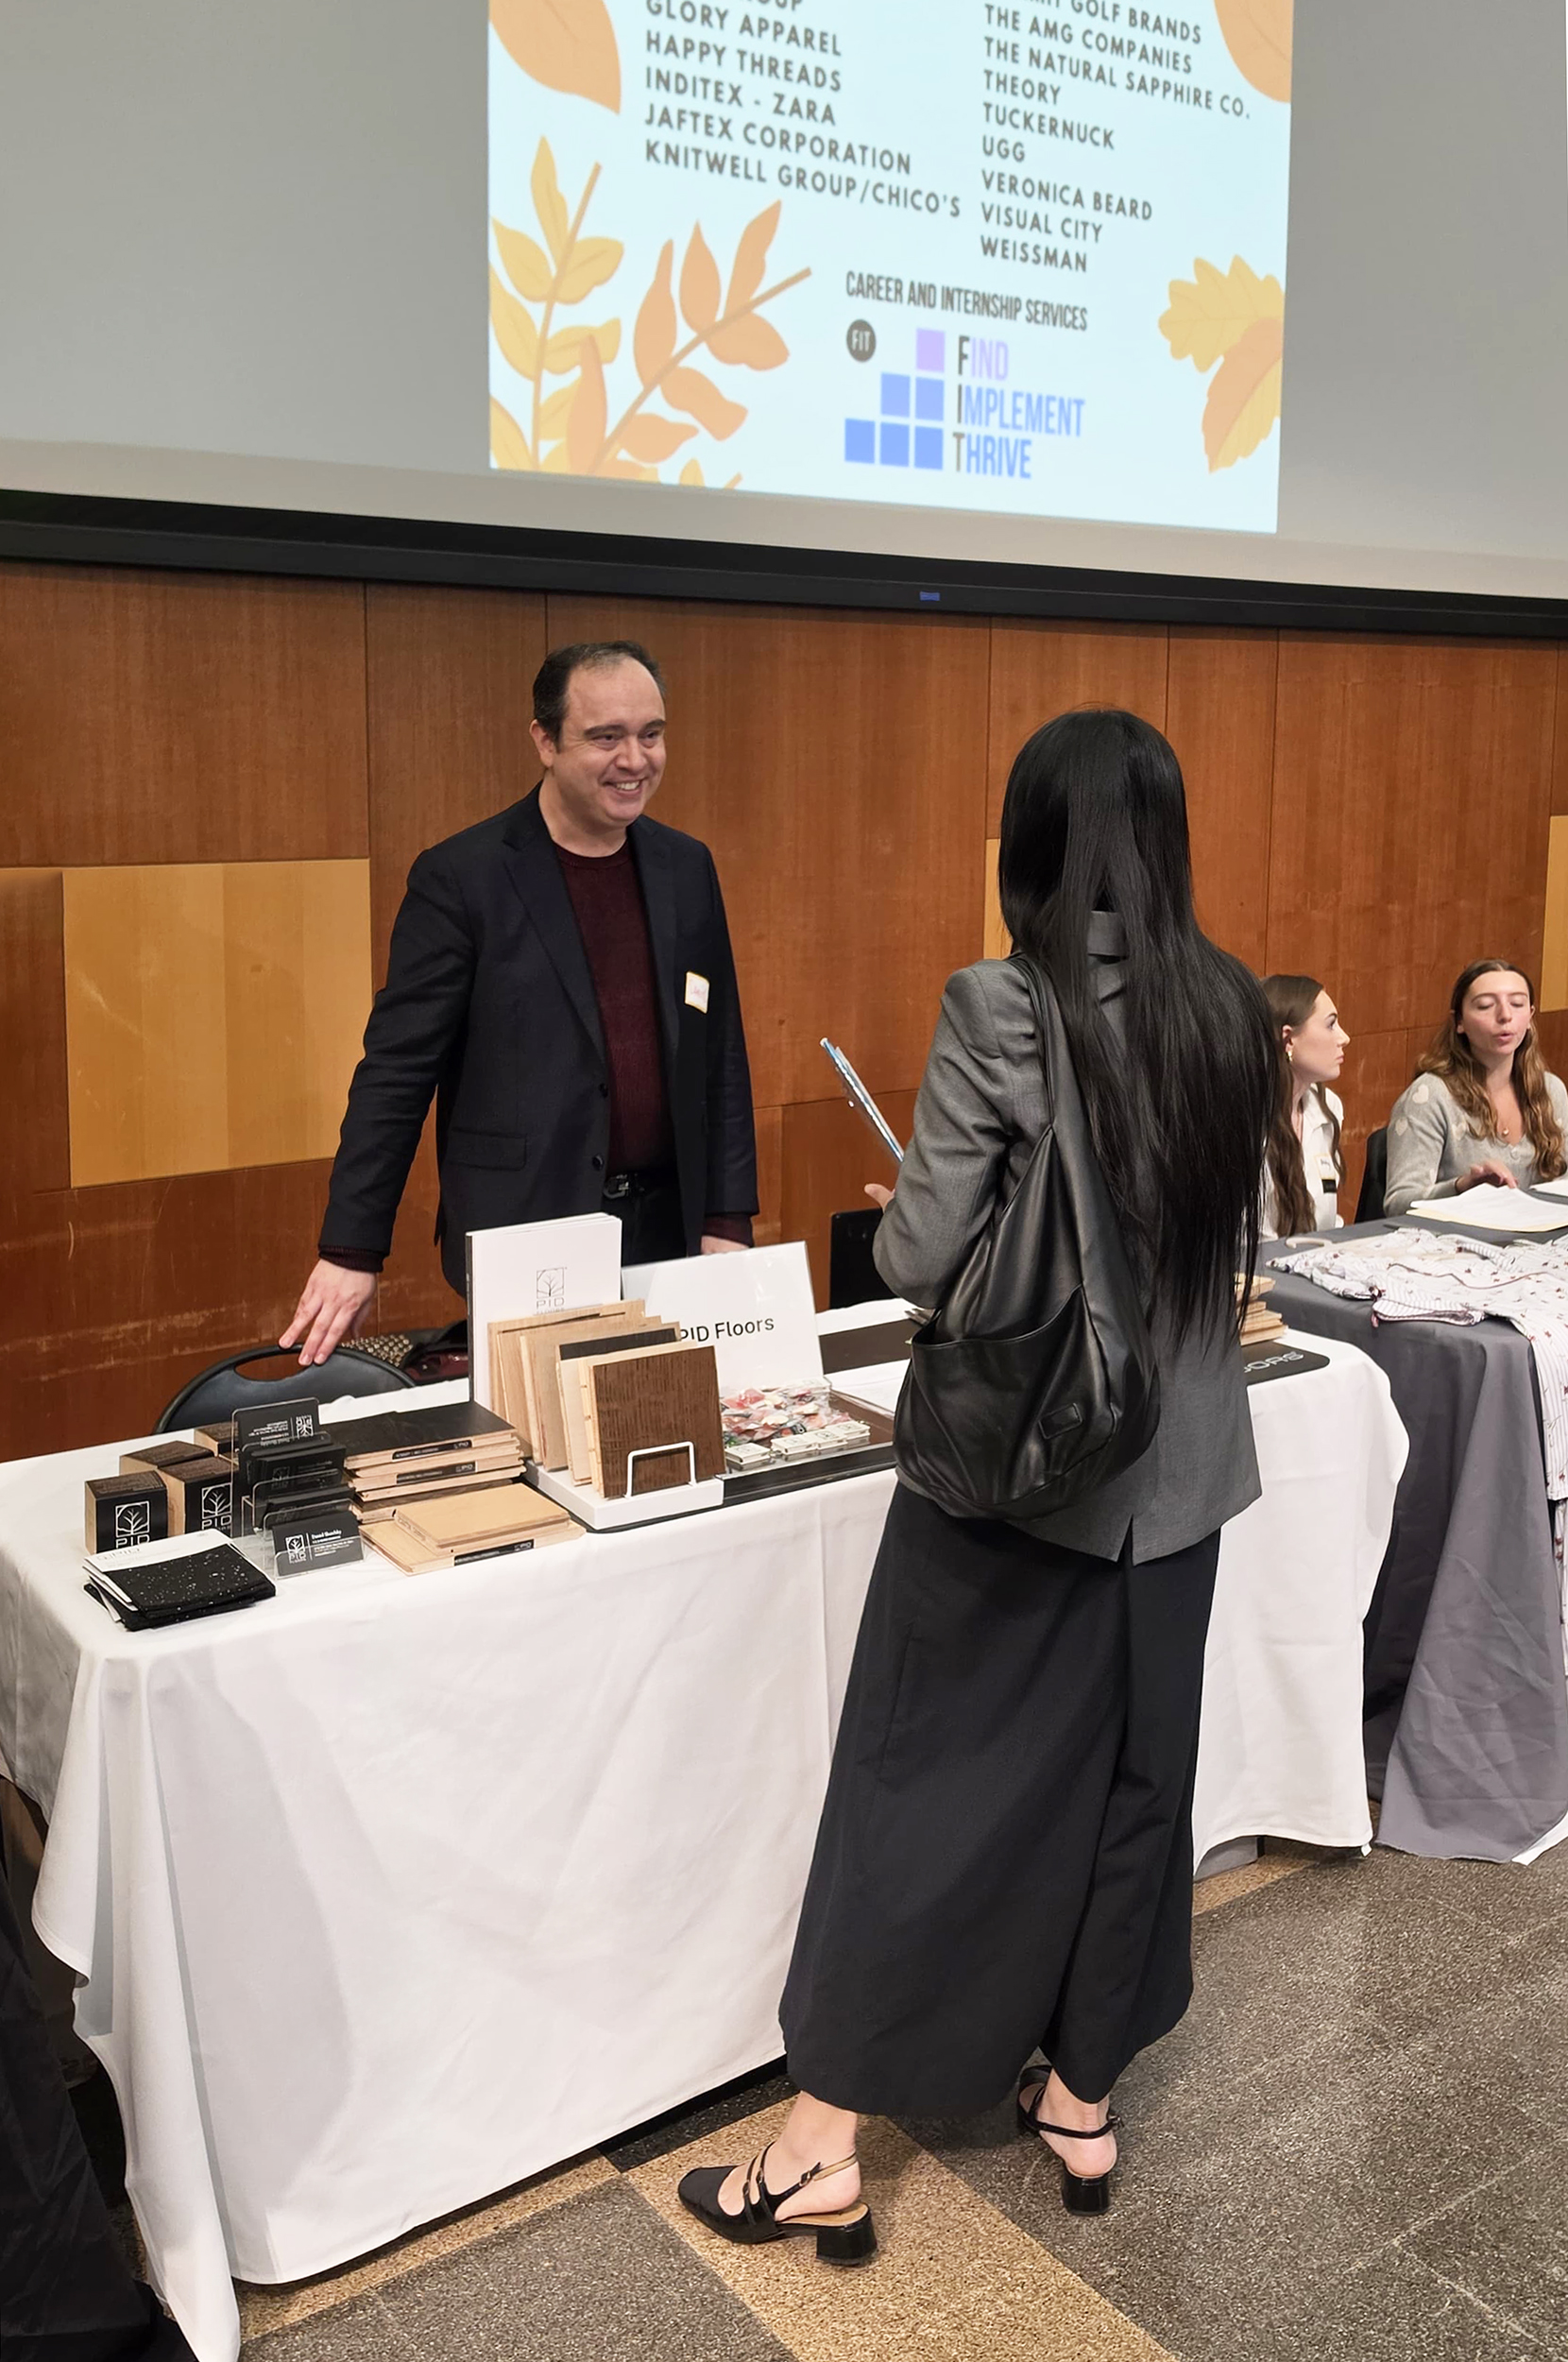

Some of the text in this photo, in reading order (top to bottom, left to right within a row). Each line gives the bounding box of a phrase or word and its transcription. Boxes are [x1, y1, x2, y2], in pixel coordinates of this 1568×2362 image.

[646, 0, 841, 56] GLORY APPAREL
[985, 4, 1192, 74] THE AMG COMPANIES
[1071, 0, 1201, 43] GOLF BRANDS
[646, 30, 842, 92] HAPPY THREADS
[984, 37, 1250, 119] THE NATURAL SAPPHIRE CO.
[646, 67, 743, 107] INDITEX
[773, 94, 836, 126] ZARA
[983, 70, 1061, 105] THEORY
[645, 103, 911, 175] JAFTEX CORPORATION
[982, 135, 1026, 162] UGG
[983, 102, 1115, 149] TUCKERNUCK
[646, 140, 960, 217] KNITWELL GROUP/CHICO'S
[981, 169, 1152, 220] VERONICA BEARD
[981, 202, 1102, 243] VISUAL CITY
[980, 235, 1087, 272] WEISSMAN
[845, 270, 1088, 331] CAREER AND INTERNSHIP SERVICES
[851, 330, 871, 351] FIT
[958, 334, 1009, 381] FIND
[958, 384, 1085, 437] IMPLEMENT
[952, 432, 1032, 479] THRIVE
[715, 1318, 775, 1339] Floors
